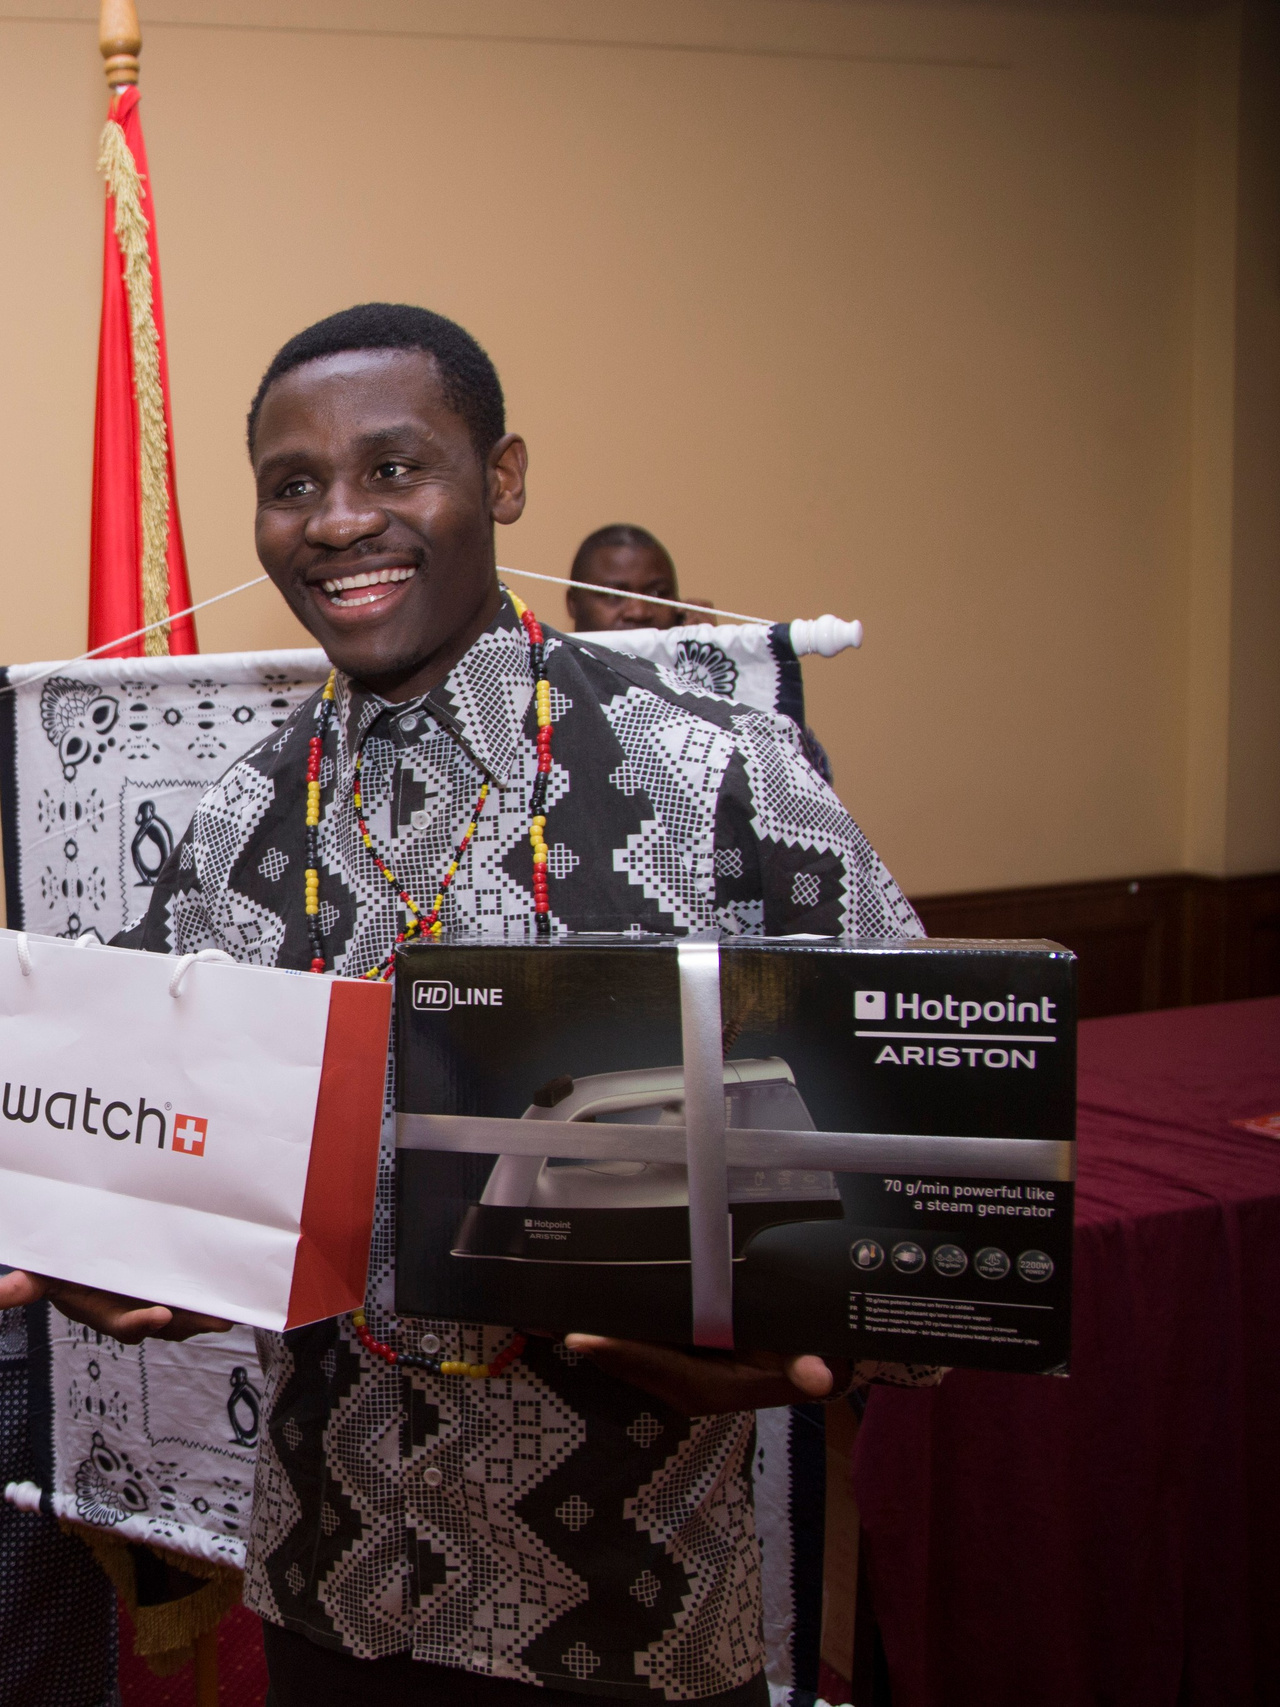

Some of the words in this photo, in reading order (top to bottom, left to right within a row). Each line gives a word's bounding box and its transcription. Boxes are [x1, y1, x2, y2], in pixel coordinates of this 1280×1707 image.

[417, 987, 447, 1004] HD
[454, 987, 503, 1006] LINE
[896, 992, 1057, 1029] Hotpoint
[874, 1045, 1036, 1069] ARISTON
[884, 1179, 902, 1192] 70
[906, 1180, 949, 1196] g/min
[954, 1183, 1022, 1199] powerful
[1026, 1187, 1055, 1201] like
[914, 1200, 923, 1210] a
[927, 1200, 973, 1213] steam
[978, 1203, 1055, 1218] generator
[534, 1220, 571, 1230] Hotpoint
[1020, 1260, 1050, 1270] 2200W
